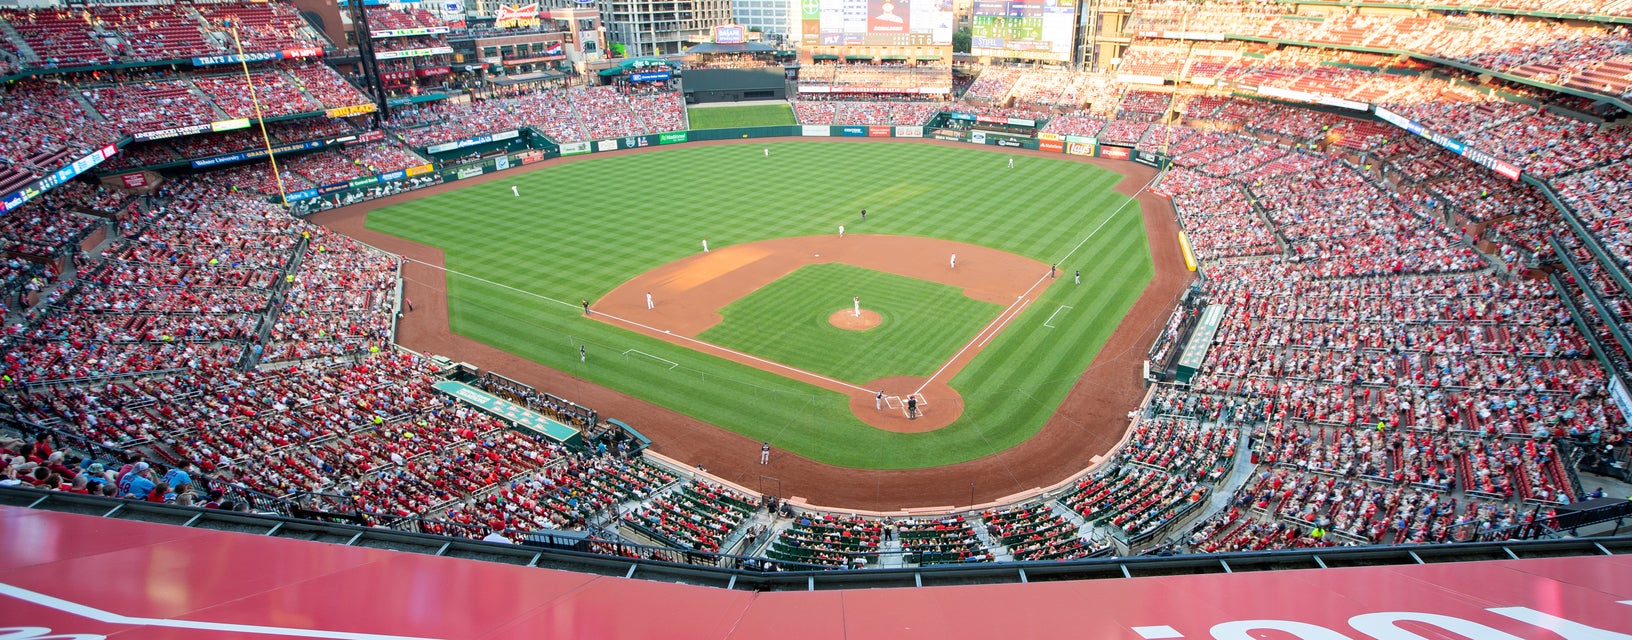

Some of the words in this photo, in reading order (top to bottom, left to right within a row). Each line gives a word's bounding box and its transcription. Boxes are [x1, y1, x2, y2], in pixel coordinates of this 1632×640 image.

[495, 9, 539, 19] Budweiser
[824, 34, 840, 44] FLY
[299, 48, 317, 57] MPH
[199, 56, 225, 65] THAT'S
[350, 105, 373, 114] MAC
[1070, 142, 1091, 155] Lay's
[215, 154, 240, 163] University
